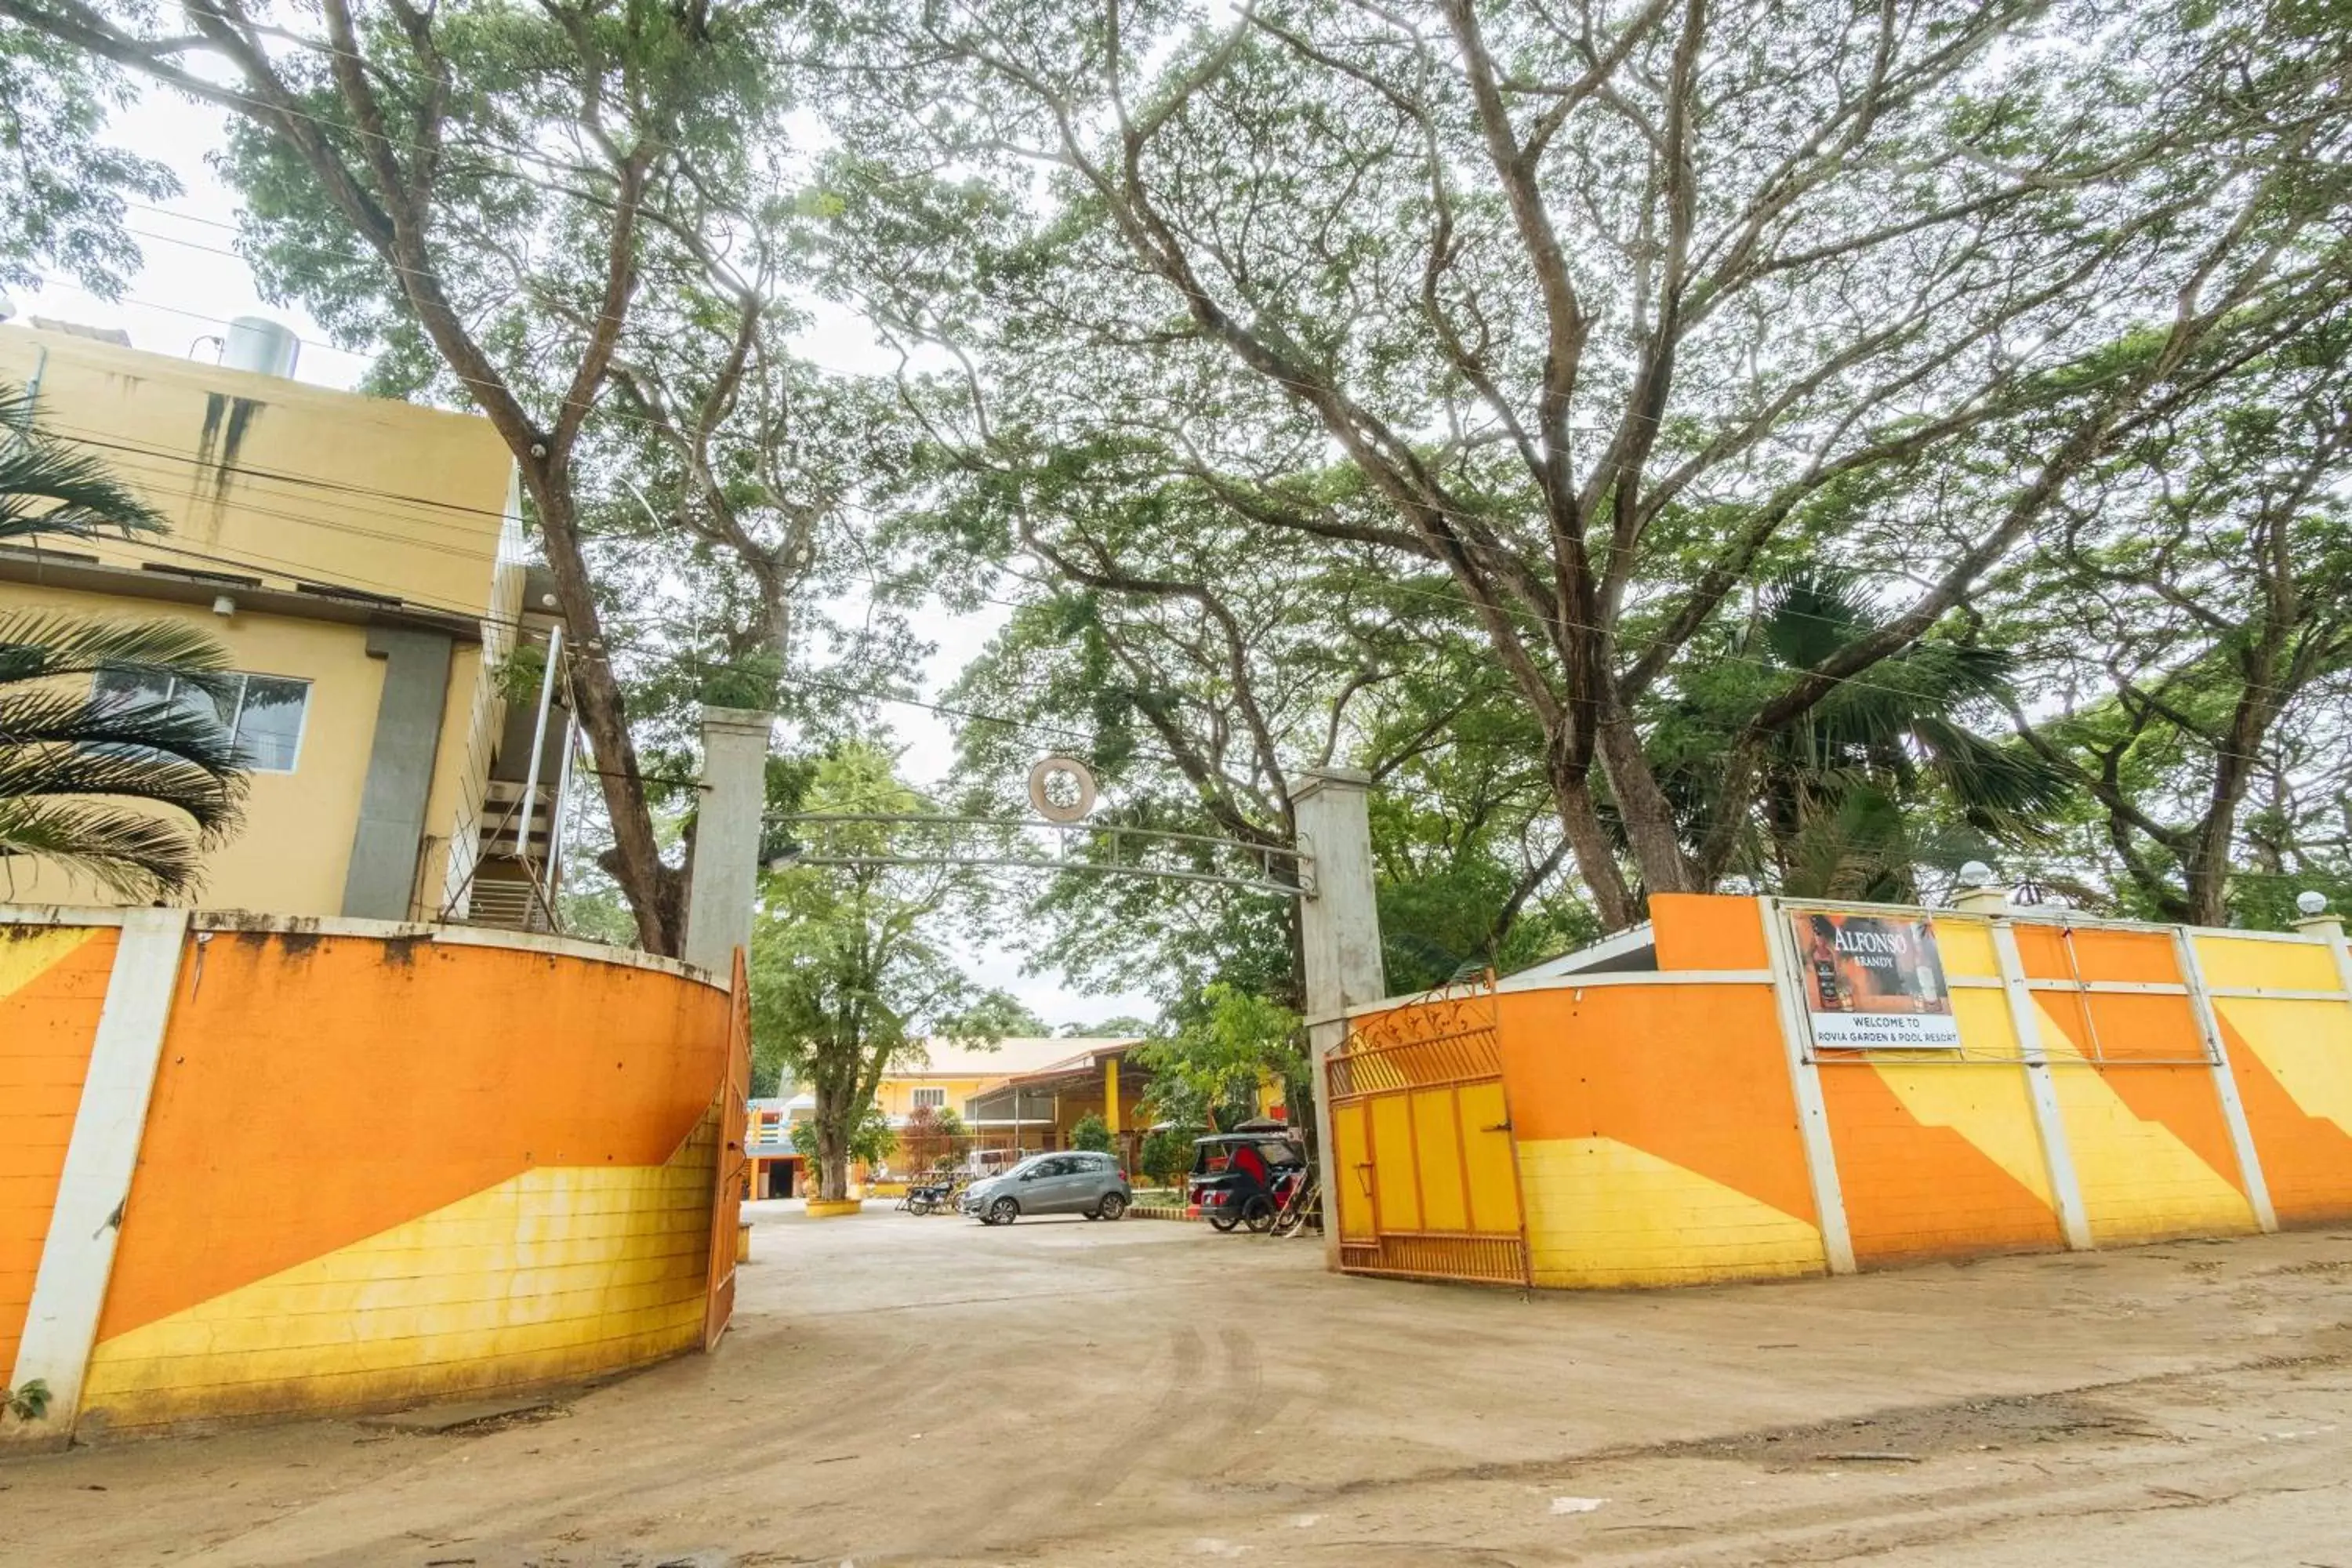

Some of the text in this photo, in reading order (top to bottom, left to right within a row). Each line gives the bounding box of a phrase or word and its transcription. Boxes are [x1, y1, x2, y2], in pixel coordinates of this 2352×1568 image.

[1835, 927, 1907, 953] ALFONSO
[1853, 1017, 1920, 1028] WELCOME TO
[1818, 1032, 1957, 1042] ROVIA GARDEN & POOL RESORT
